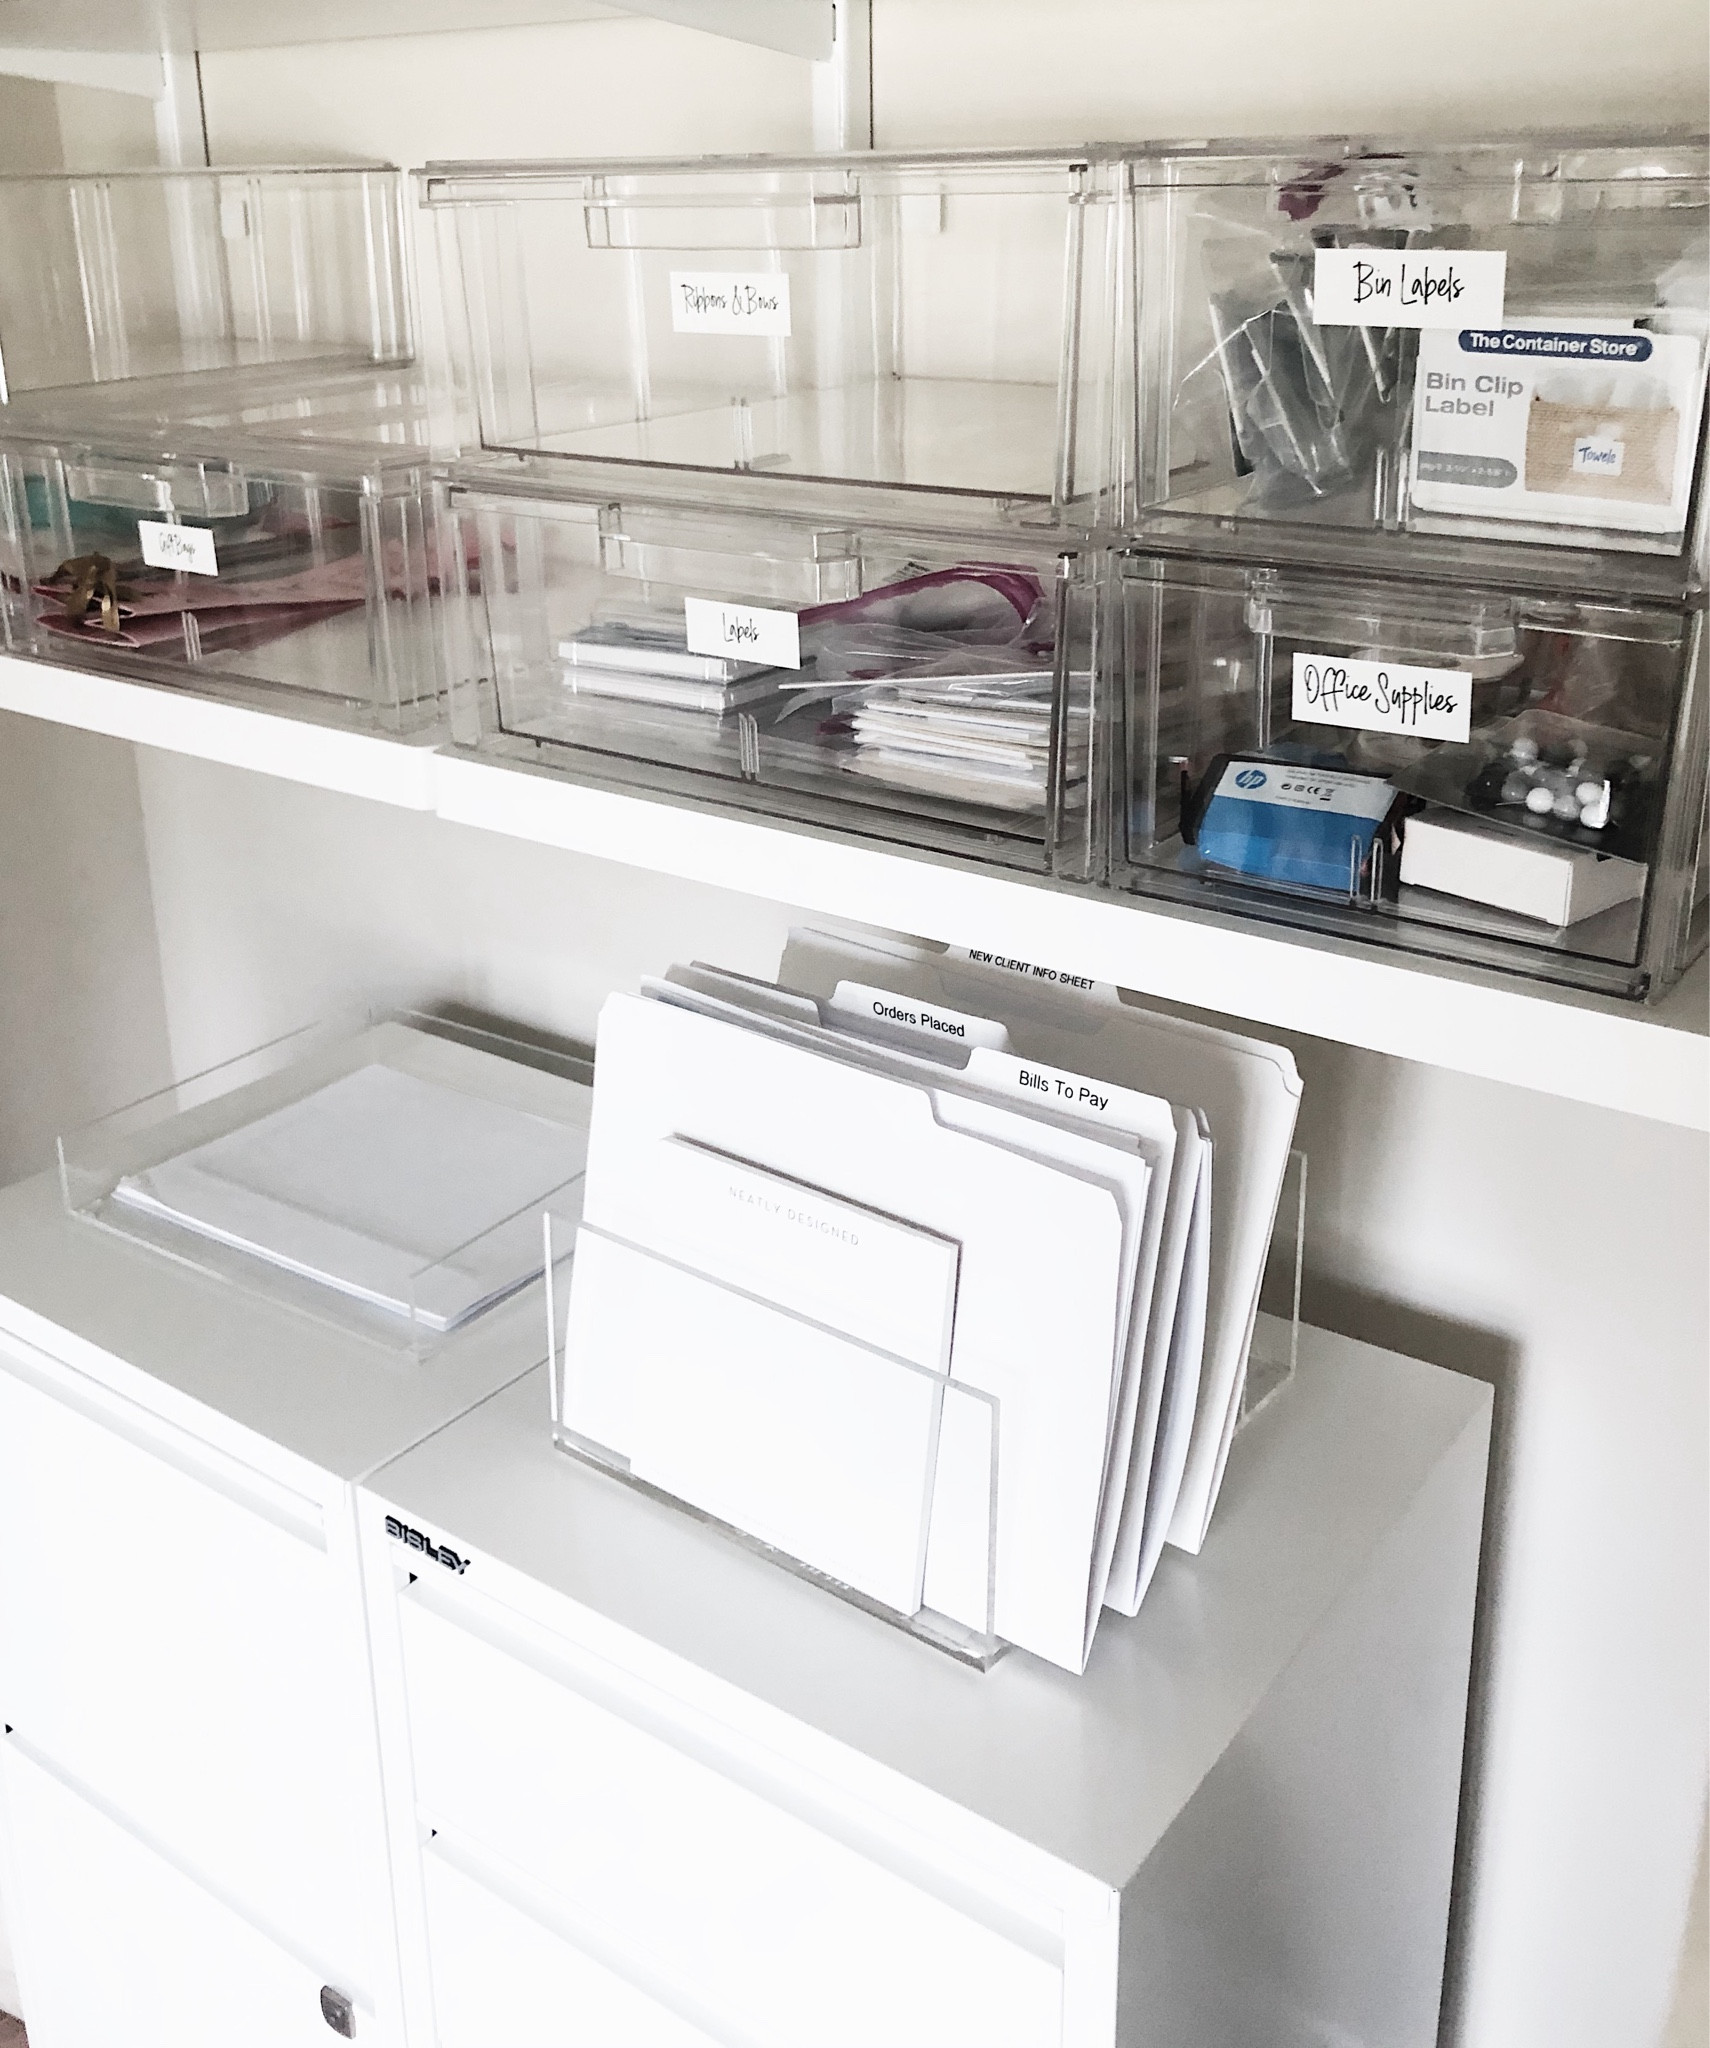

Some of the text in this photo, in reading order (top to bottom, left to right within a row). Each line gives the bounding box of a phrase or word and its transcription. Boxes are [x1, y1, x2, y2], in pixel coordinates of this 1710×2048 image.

[680, 283, 779, 316] Ribbons & Bows
[1353, 261, 1465, 305] Bin Labels
[1469, 332, 1638, 357] The Container Store
[1426, 372, 1524, 398] Bin Clip
[1425, 395, 1495, 417] Label
[1578, 446, 1617, 465] Towels
[722, 612, 760, 644] Labels
[1304, 664, 1458, 726] Office Supplies
[968, 949, 1095, 990] NEW CLIENT INFO SHEET
[873, 1001, 965, 1037] Orders Placed
[1019, 1069, 1109, 1111] Bills To Pay
[729, 1186, 859, 1246] NEATLY DESIGNED
[385, 1514, 471, 1575] BISLEY
